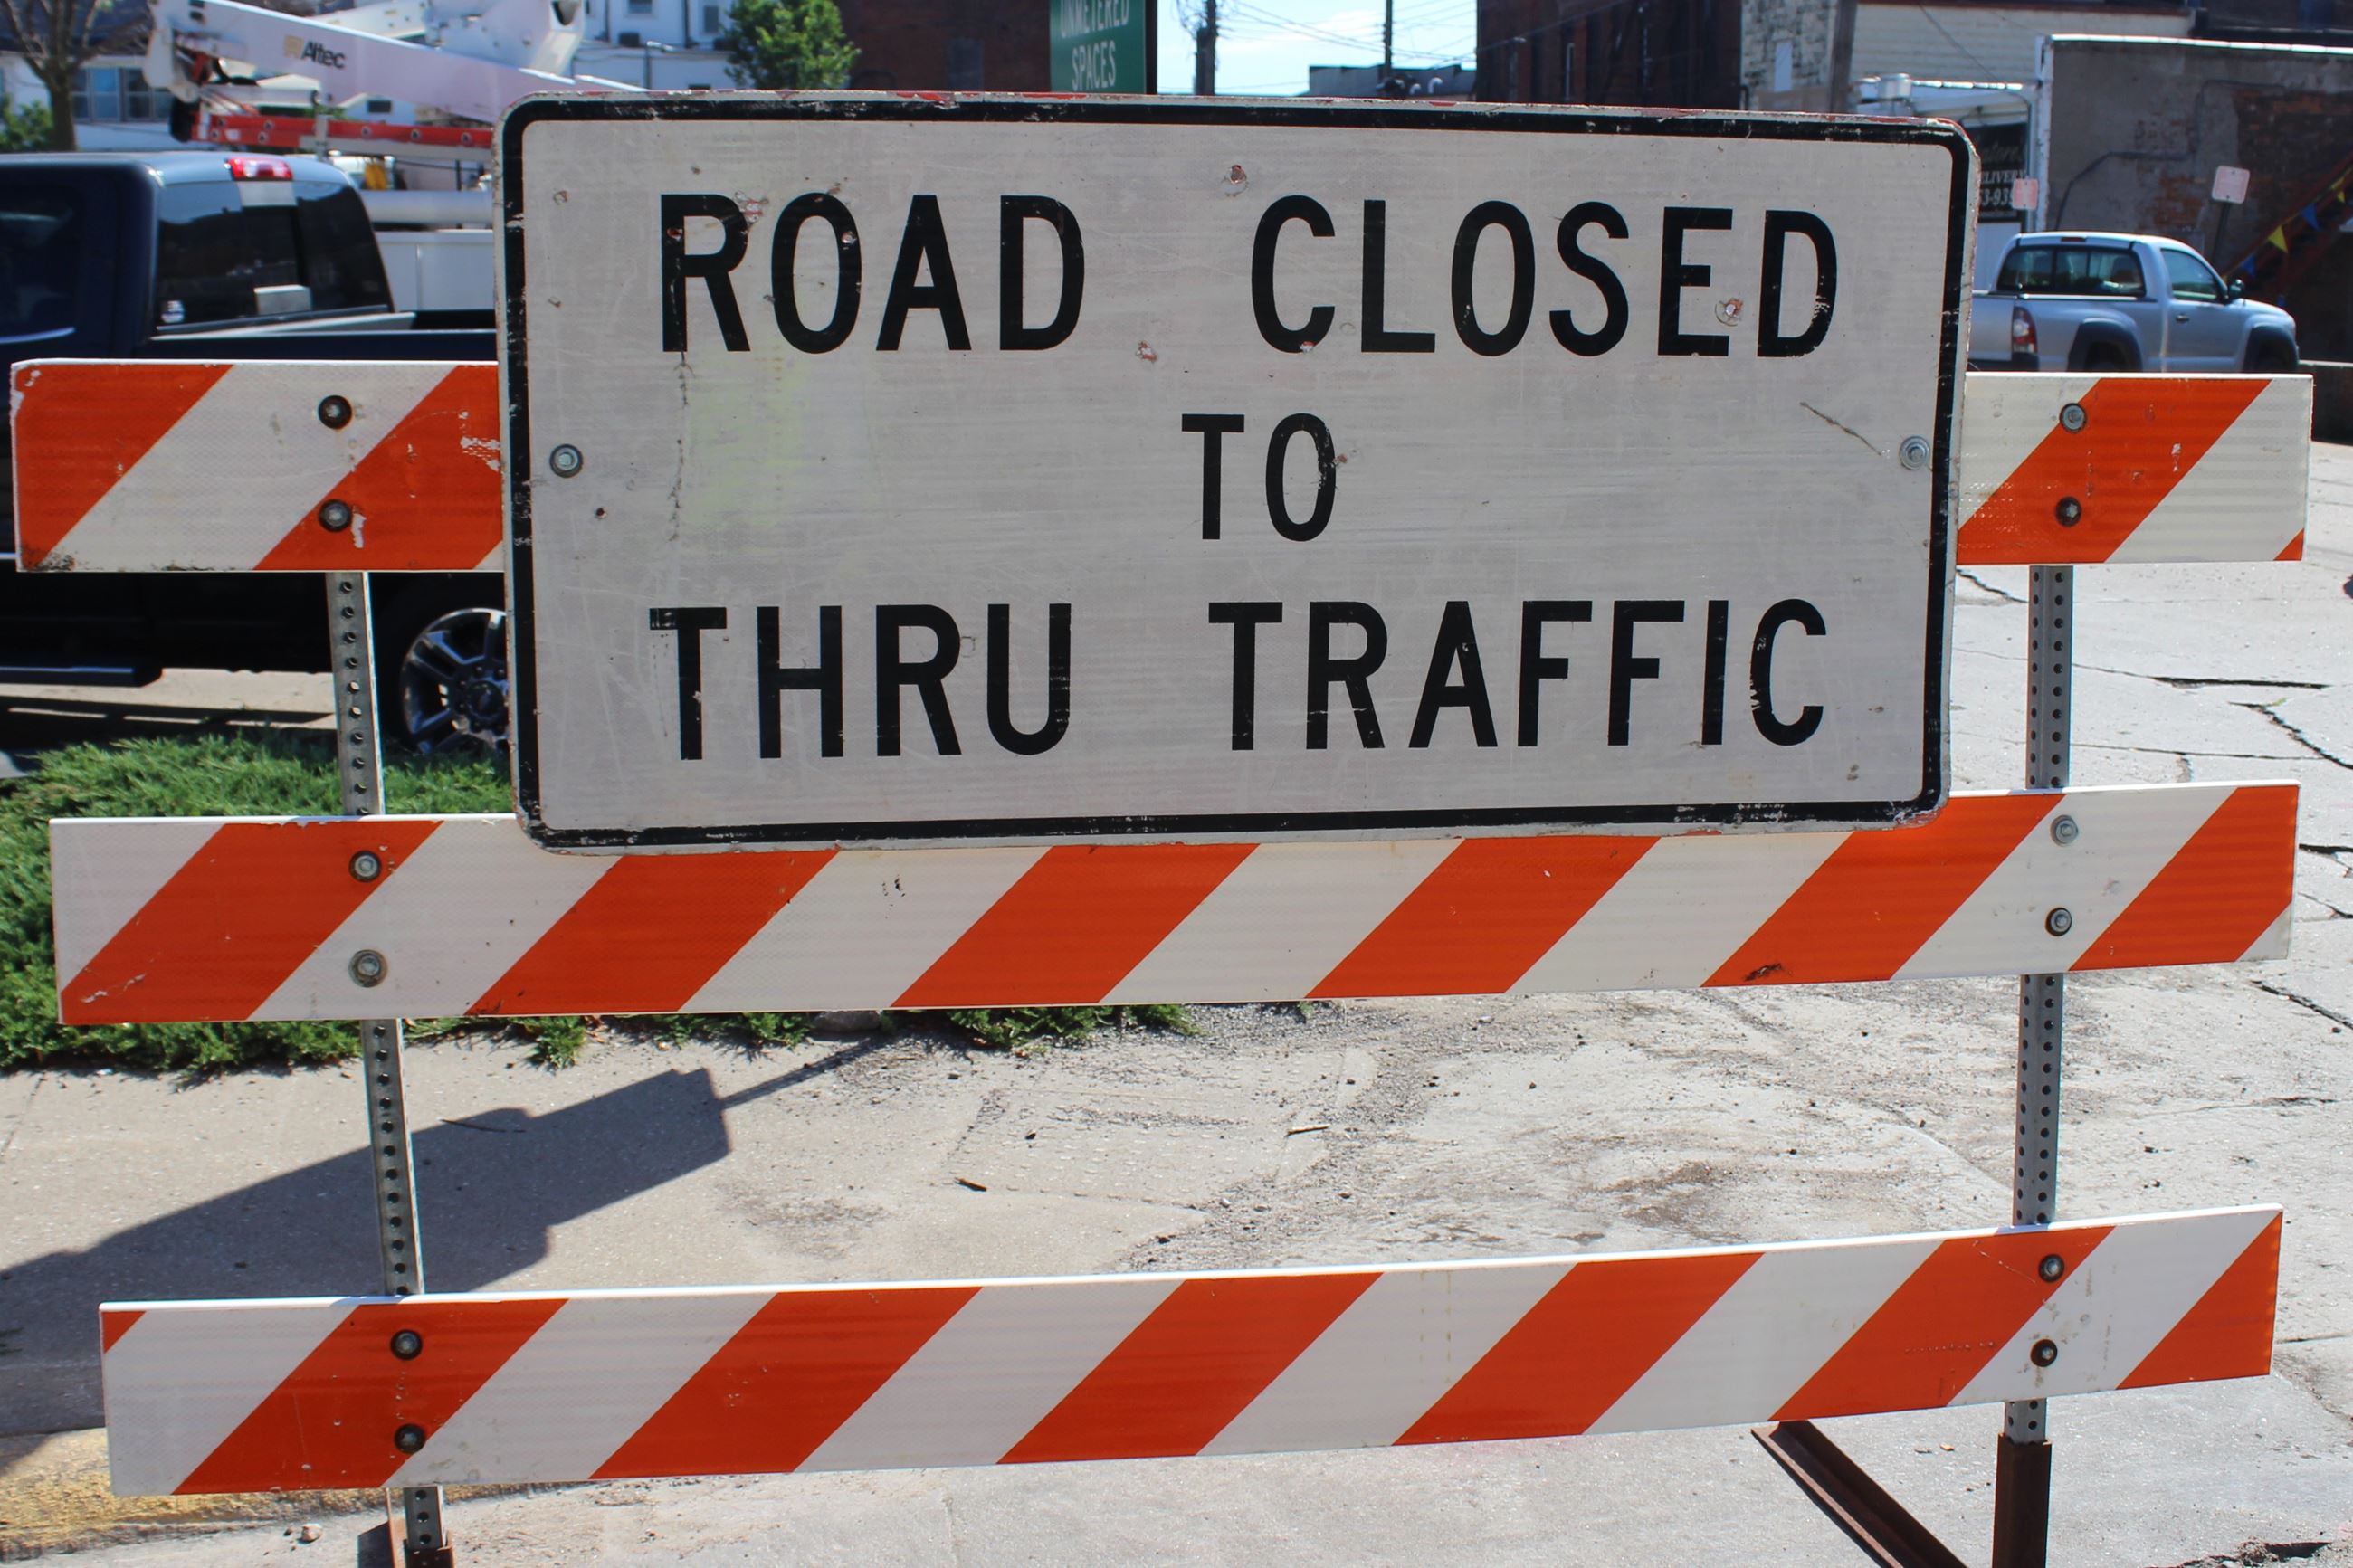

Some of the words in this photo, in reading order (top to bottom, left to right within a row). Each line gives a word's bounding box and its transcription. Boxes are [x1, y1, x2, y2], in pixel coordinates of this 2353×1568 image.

[300, 41, 346, 69] Altec
[1072, 41, 1116, 90] SPACES
[661, 192, 1084, 354] ROAD
[1252, 195, 1837, 358] CLOSED
[1182, 413, 1338, 541] TO
[650, 603, 1071, 760] THRU
[1209, 599, 1826, 750] TRAFFIC
